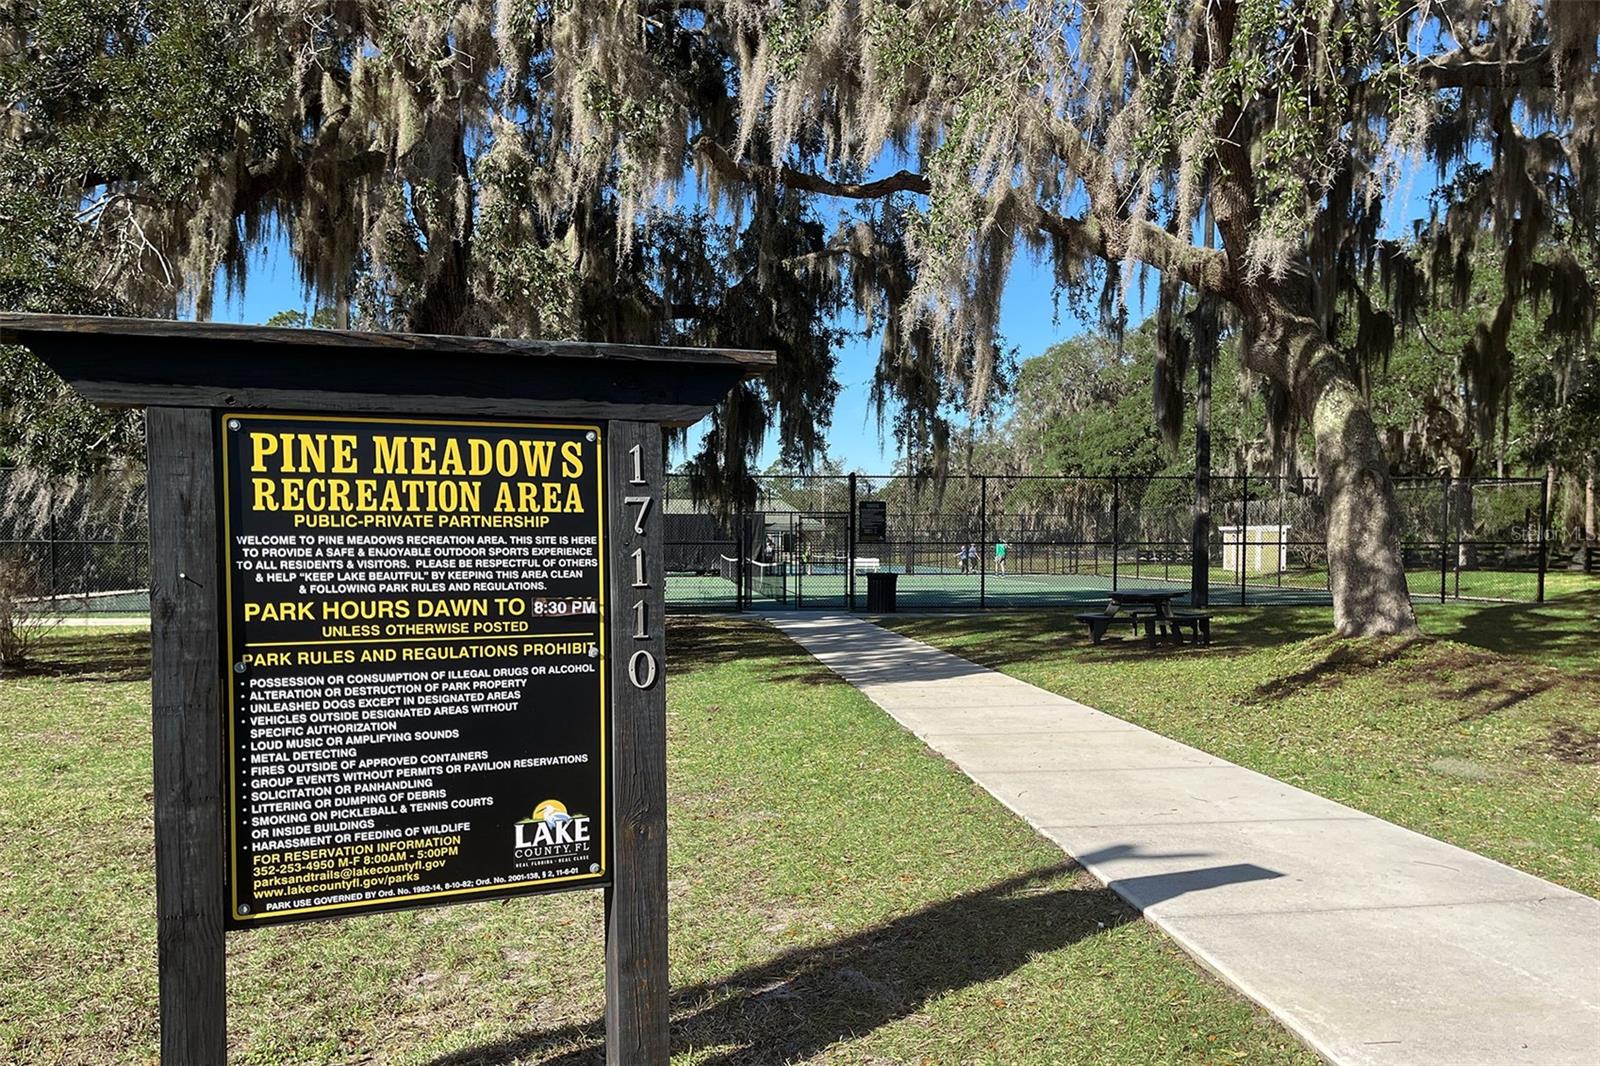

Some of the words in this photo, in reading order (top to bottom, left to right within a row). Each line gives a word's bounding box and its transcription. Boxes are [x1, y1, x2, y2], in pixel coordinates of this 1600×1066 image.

[249, 432, 358, 474] PINE
[372, 435, 584, 479] MEADOWS
[251, 478, 482, 513] RECREATION
[493, 481, 585, 513] AREA
[294, 514, 434, 528] PUBLIC-PRIVATE
[438, 514, 550, 528] PARTNERSHIP
[235, 535, 297, 546] WELCOME
[298, 535, 316, 546] TO
[317, 535, 345, 545] PINE
[346, 535, 405, 546] MEADOWS
[406, 535, 475, 545] RECREATION
[476, 535, 508, 545] AREA.
[509, 535, 534, 545] THIS
[534, 535, 558, 545] SITE
[558, 535, 570, 545] IS
[570, 535, 598, 545] HERE
[241, 547, 259, 558] TO
[261, 547, 313, 558] PROVIDE
[314, 547, 324, 558] A
[325, 547, 355, 558] SAFE
[357, 547, 366, 558] &
[367, 547, 432, 557] ENJOYABLE
[433, 547, 486, 557] OUTDOOR
[488, 547, 530, 557] SPORTS
[531, 547, 593, 557] EXPERIENCE
[235, 560, 253, 571] TO
[255, 560, 278, 570] ALL
[279, 559, 344, 570] RESIDENTS
[346, 559, 355, 570] &
[356, 559, 410, 570] VISITORS.
[415, 558, 457, 569] PLEASE
[458, 558, 473, 569] BE
[475, 558, 541, 568] RESPECTFUL
[542, 558, 557, 568] OF
[558, 558, 598, 568] OTHERS
[255, 572, 264, 583] &
[266, 572, 297, 583] HELP
[337, 571, 367, 582] LAKE
[431, 570, 446, 581] BY
[447, 570, 494, 580] KEEPING
[495, 570, 520, 580] THIS
[520, 569, 549, 579] AREA
[550, 569, 583, 579] CLEAN
[624, 443, 657, 688] 17110
[298, 584, 307, 595] &
[309, 583, 377, 595] FOLLOWING
[378, 583, 409, 593] PARK
[411, 582, 447, 593] RULES
[447, 582, 471, 592] AND
[473, 581, 548, 592] REGULATIONS.
[244, 601, 316, 622] PARK
[322, 599, 411, 620] HOURS
[417, 598, 488, 618] DAWN
[494, 597, 526, 616] TO
[533, 600, 567, 615] 8:30
[571, 600, 597, 614] PM
[322, 624, 381, 638] UNLESS
[385, 622, 470, 636] OTHERWISE
[473, 620, 529, 634] POSTED
[242, 652, 292, 667] PARK
[297, 649, 356, 665] RULES
[360, 648, 397, 663] AND
[402, 643, 519, 661] REGULATIONS
[249, 675, 325, 689] POSSESSION
[326, 674, 345, 685] OR
[346, 671, 429, 685] CONSUMPTION
[430, 670, 446, 681] OF
[447, 668, 492, 680] ILLEGAL
[492, 666, 529, 678] DRUGS
[530, 665, 547, 676] OR
[547, 663, 596, 675] ALCOHOL
[249, 688, 322, 701] ALTERATION
[324, 687, 342, 698] OR
[343, 683, 422, 697] DESTRUCTION
[423, 682, 440, 693] OF
[441, 681, 471, 692] PARK
[472, 678, 528, 690] PROPERTY
[249, 713, 308, 726] VEHICLES
[309, 710, 360, 723] OUTSIDE
[361, 707, 432, 720] DESIGNATED
[433, 704, 470, 716] AREAS
[470, 701, 519, 714] WITHOUT
[250, 700, 321, 714] UNLEASHED
[322, 698, 356, 710] DOGS
[358, 696, 401, 708] EXCEPT
[403, 696, 415, 706] IN
[417, 692, 485, 705] DESIGNATED
[486, 690, 522, 701] AREAS
[250, 725, 304, 739] SPECIFIC
[306, 720, 397, 736] AUTHORIZATION
[250, 739, 284, 752] LOUD
[285, 737, 324, 749] MUSIC
[325, 736, 343, 747] OR
[345, 731, 412, 746] AMPLIFYING
[414, 728, 460, 741] SOUNDS
[250, 752, 291, 764] METAL
[292, 747, 357, 761] DETECTING
[250, 764, 286, 777] FIRES
[287, 760, 339, 774] OUTSIDE
[340, 759, 357, 770] OF
[358, 755, 419, 769] APPROVED
[420, 750, 489, 765] CONTAINERS
[250, 776, 294, 789] GROUP
[295, 772, 341, 786] EVENTS
[342, 769, 394, 782] WITHOUT
[396, 765, 444, 778] PERMITS
[445, 764, 462, 774] OR
[463, 760, 512, 773] PAVILION
[513, 753, 589, 769] RESERVATIONS
[250, 785, 333, 802] SOLICITATION
[334, 784, 352, 795] OR
[354, 778, 433, 794] PANHANDLING
[251, 799, 312, 815] LITTERING
[314, 798, 332, 809] OR
[334, 793, 387, 807] DUMPING
[388, 792, 405, 803] OF
[406, 788, 447, 801] DEBRIS
[251, 812, 308, 827] SMOKING
[309, 810, 328, 822] ON
[330, 805, 398, 820] PICKLEBALL
[399, 804, 408, 814] &
[409, 800, 449, 813] TENNIS
[450, 796, 494, 809] COURTS
[251, 828, 270, 840] OR
[272, 824, 312, 838] INSIDE
[313, 818, 375, 834] BUILDINGS
[252, 834, 333, 852] HARASSMENT
[334, 833, 352, 844] OR
[354, 828, 403, 842] FEEDING
[404, 826, 420, 837] OF
[421, 821, 471, 835] WILDLIFE
[514, 816, 591, 849] LAKE
[253, 853, 281, 866] FOR
[284, 843, 374, 863] RESERVATION
[376, 835, 461, 853] INFORMATION
[574, 842, 590, 852] FL
[253, 858, 335, 877] 352-253-4950
[337, 855, 361, 868] M-F
[363, 851, 407, 865] 8:00AM
[416, 845, 459, 860] 5:00PM
[253, 859, 446, 891] parksandtrails@lakecountyfl.gov
[253, 871, 420, 900] www.lakecountyfl.gov/parks
[266, 900, 292, 911] PARK
[292, 898, 312, 908] USE
[313, 892, 364, 906] GOVERNED
